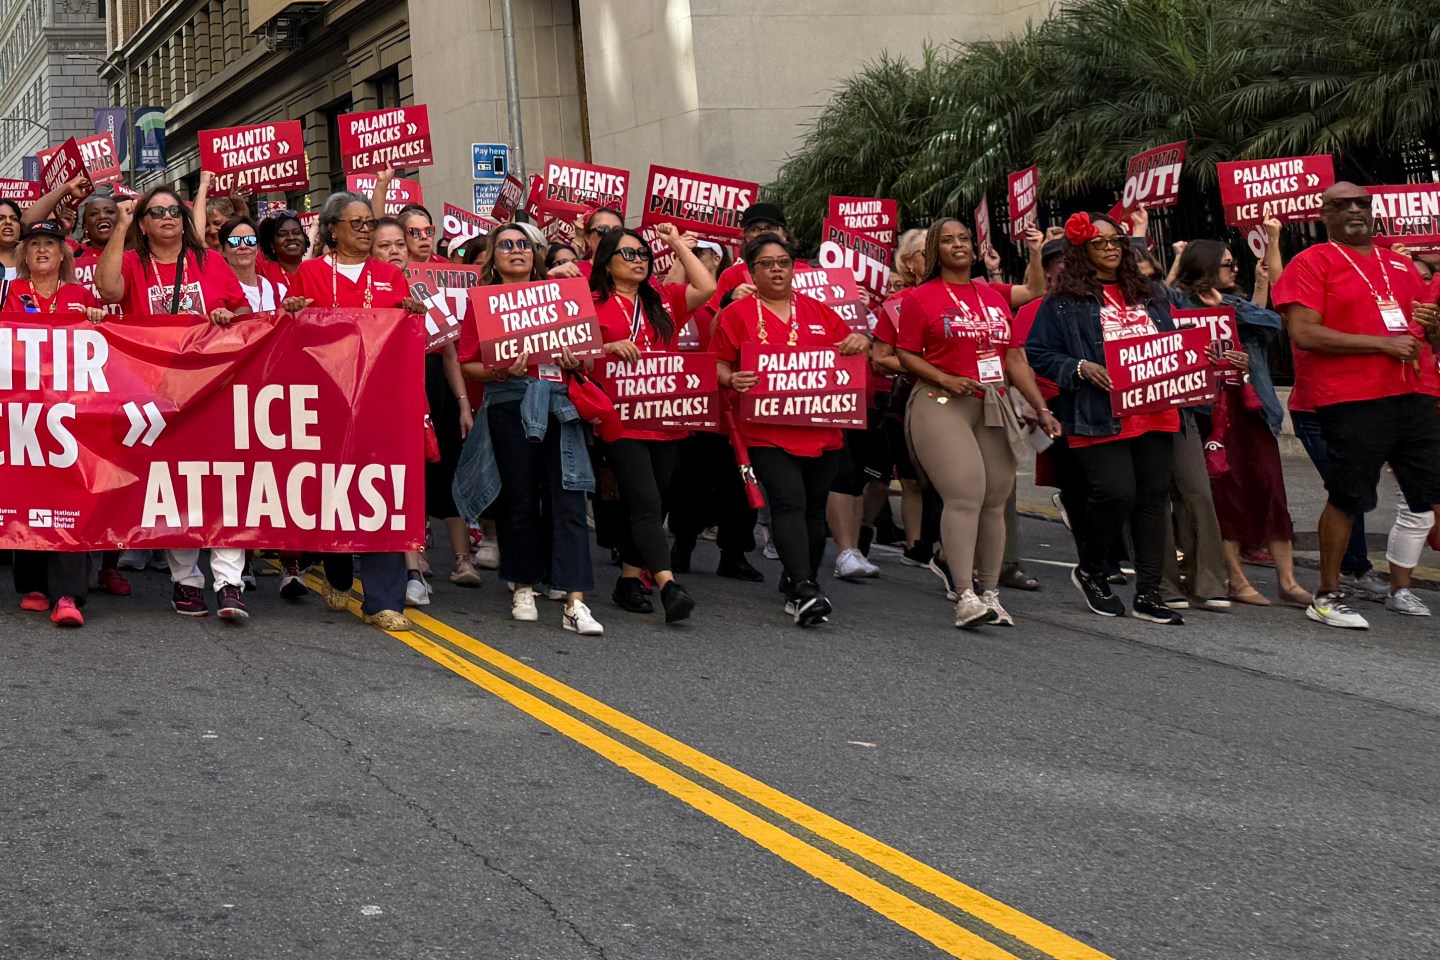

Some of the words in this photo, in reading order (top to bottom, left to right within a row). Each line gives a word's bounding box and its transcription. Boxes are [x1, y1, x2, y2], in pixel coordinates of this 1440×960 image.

[350, 110, 405, 135] PALANTIR
[213, 126, 275, 154] PALANTIR
[358, 126, 401, 148] TRACKS
[221, 144, 271, 169] TRACKS
[352, 152, 369, 170] ICE
[372, 139, 425, 166] ATTACKS!
[475, 147, 488, 156] Pay
[1132, 149, 1179, 173] PALANTIR
[237, 160, 298, 188] ATTACKS!
[548, 164, 625, 196] PATIENTS
[1234, 159, 1304, 184] PALANTIR
[0, 182, 29, 190] PALANTIR
[1, 190, 25, 199] TRACKS
[575, 189, 598, 199] OVER
[652, 173, 751, 211] PATIENTS
[1123, 163, 1182, 208] OUT!
[1243, 176, 1299, 199] TRACKS
[684, 202, 713, 214] OVER
[838, 201, 882, 216] PALANTIR
[1237, 203, 1258, 221] ICE
[1263, 192, 1323, 217] ATTACKS
[844, 214, 878, 228] TRACKS
[1396, 216, 1429, 226] OVER
[830, 227, 887, 260] PALANTIR
[819, 240, 890, 290] OUT!
[488, 282, 561, 315] PALANTIR
[501, 303, 558, 333] TRACKS
[494, 339, 518, 361] ICE
[523, 322, 593, 355] ATTACKS!
[1120, 333, 1183, 367] PALANTIR
[758, 351, 835, 372] PALANTIR
[1128, 354, 1179, 383] TRACKS
[616, 375, 676, 397] TRACKS
[767, 371, 827, 391] TRACKS
[1122, 389, 1143, 410] ICE
[1146, 370, 1207, 404] ATTACKS!
[233, 383, 321, 450] ICE
[634, 397, 709, 420] ATTACKS!
[754, 398, 779, 416] ICE
[783, 393, 857, 415] ATTACKS!
[141, 460, 407, 531] ATTACKS!
